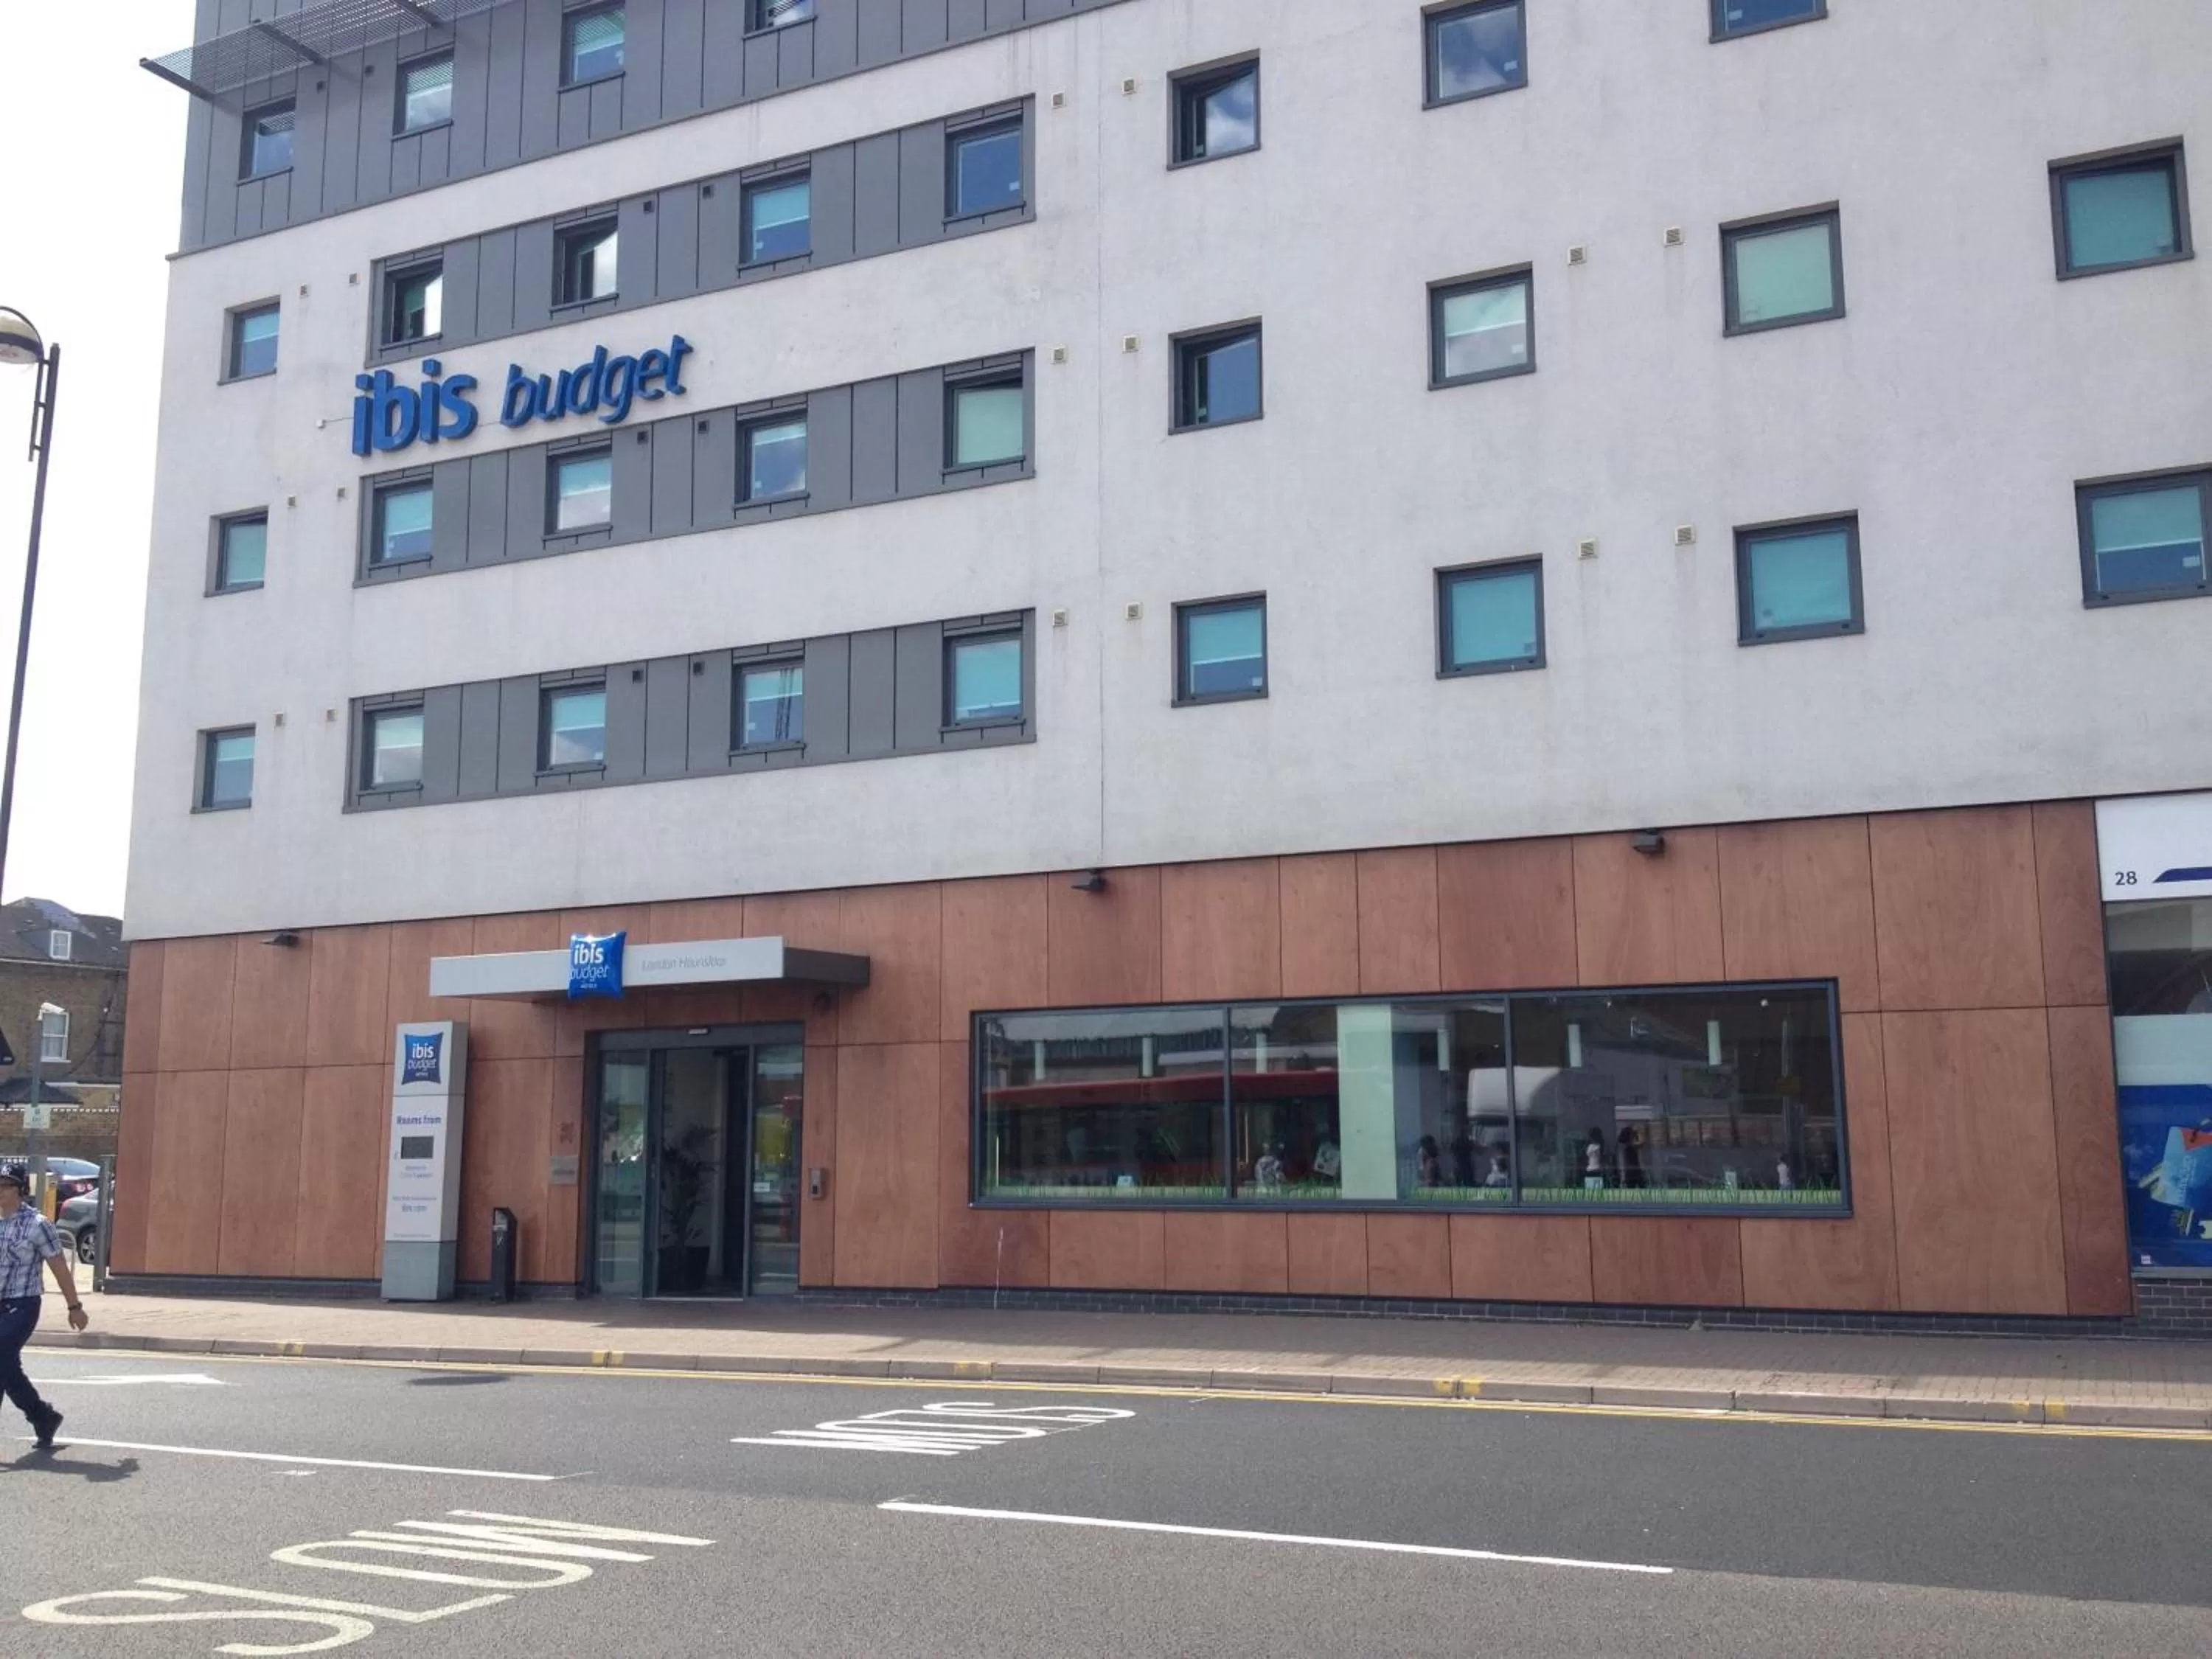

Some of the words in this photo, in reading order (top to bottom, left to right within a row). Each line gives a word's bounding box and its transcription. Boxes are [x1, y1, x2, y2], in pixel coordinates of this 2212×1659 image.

[352, 358, 479, 457] ibis
[500, 334, 695, 428] budget
[2115, 871, 2138, 886] 28
[574, 943, 605, 965] ibis
[569, 964, 610, 982] budget
[412, 1043, 435, 1058] ibis
[730, 1402, 1136, 1455] SLOW
[22, 1509, 718, 1657] SLOW
